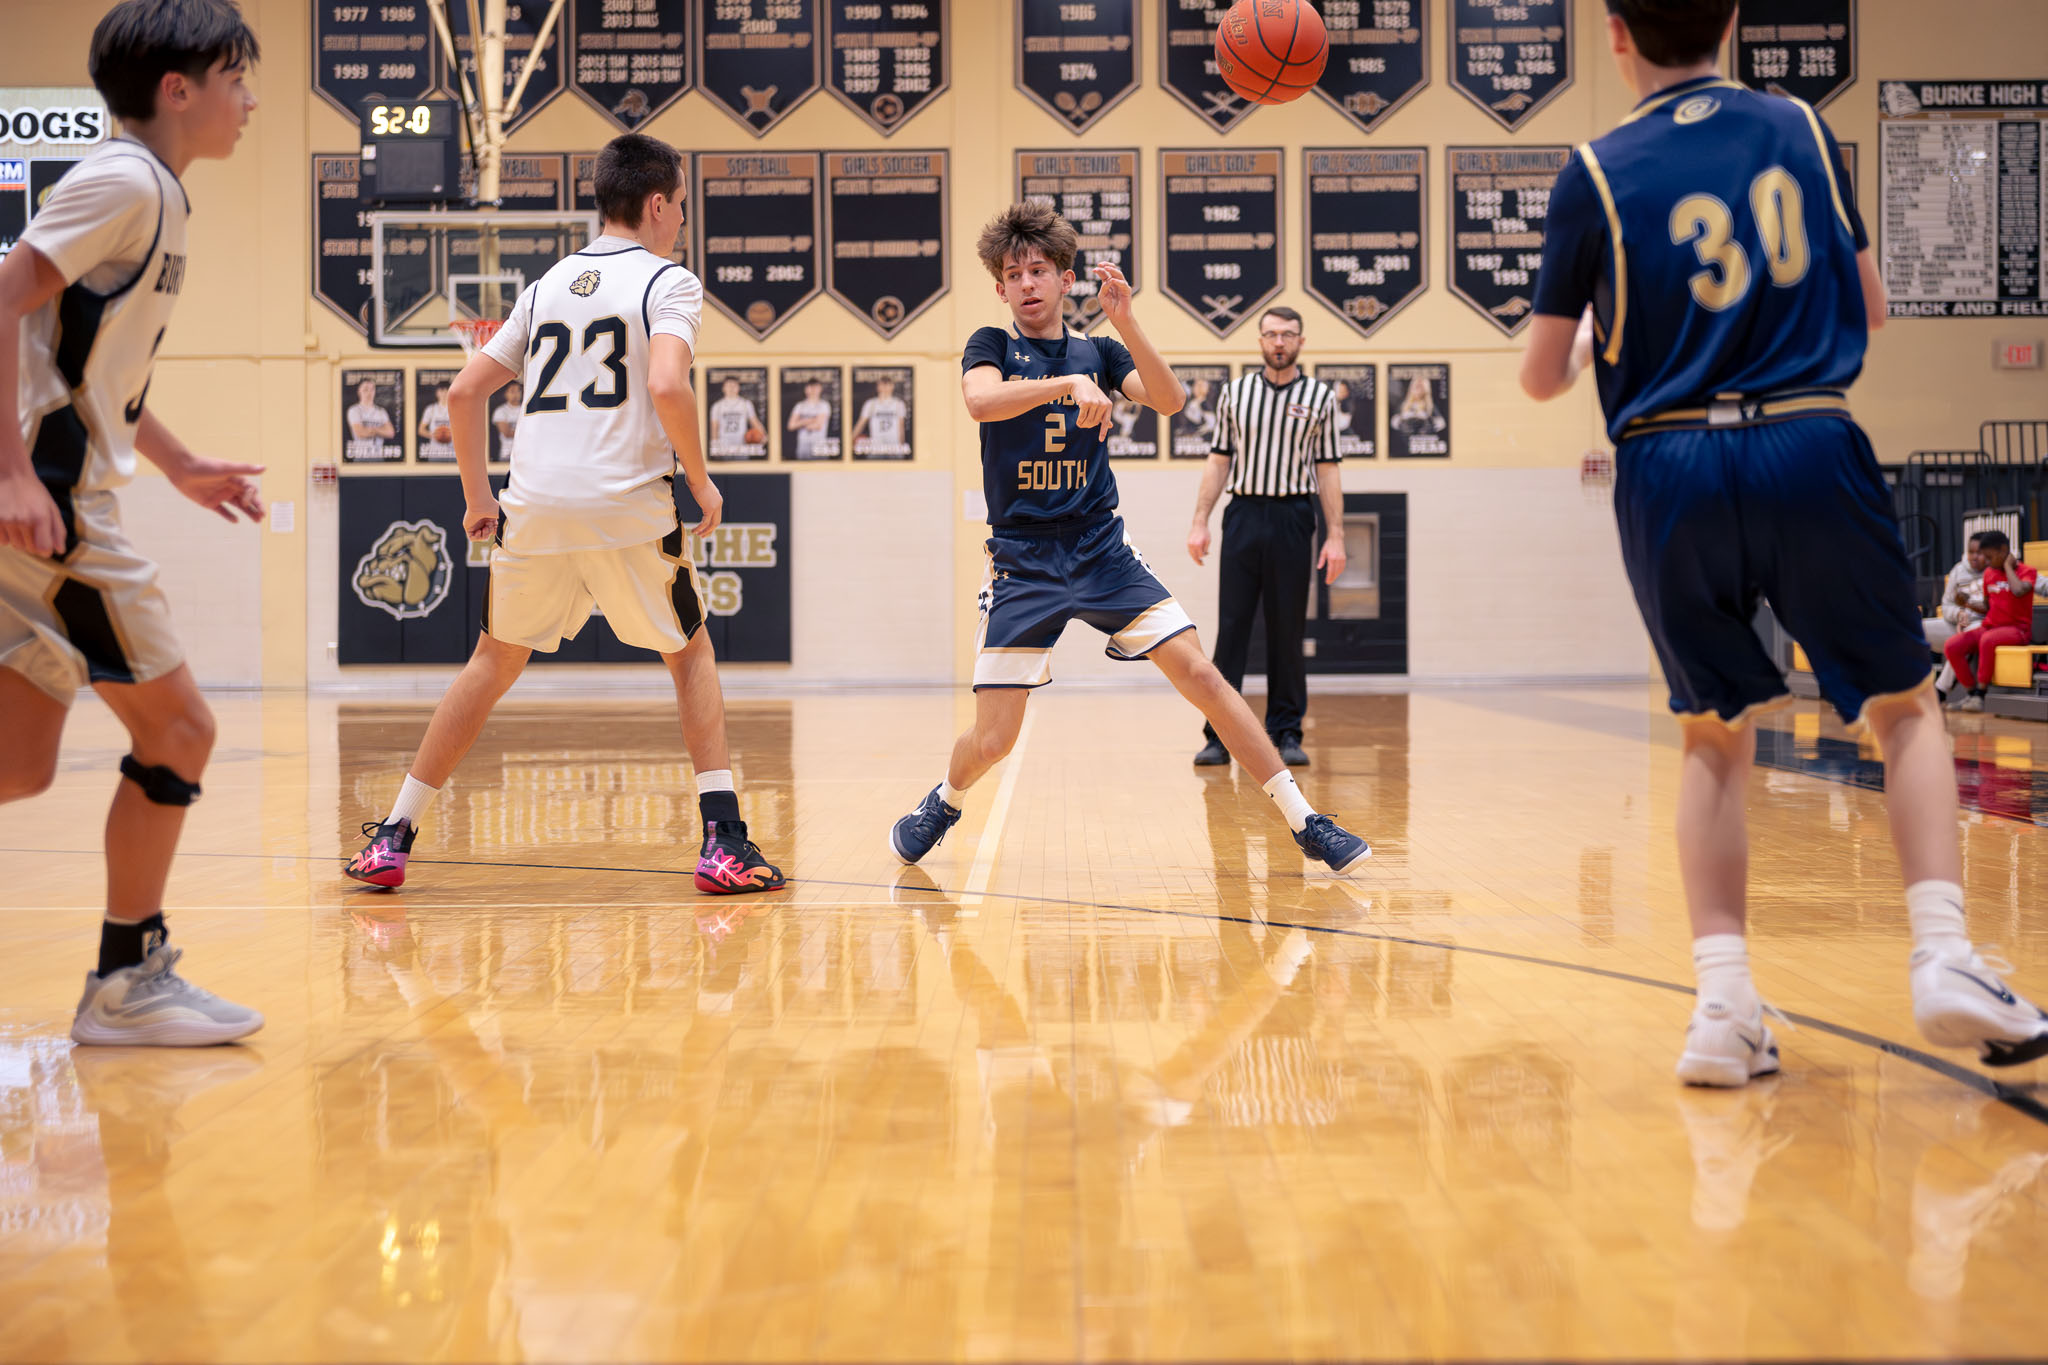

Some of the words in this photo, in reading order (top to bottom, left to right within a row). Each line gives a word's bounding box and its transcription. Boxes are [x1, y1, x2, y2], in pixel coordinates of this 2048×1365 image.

[333, 6, 369, 22] 1977
[1921, 84, 1985, 106] BURKE
[1990, 83, 2037, 105] HIGH
[321, 161, 356, 179] GIRLS
[727, 158, 791, 176] SOFTBALL
[842, 156, 878, 175] GIRLS
[881, 155, 930, 174] SOCCER
[1668, 164, 1811, 313] 30
[1888, 303, 1947, 316] TRACK
[1952, 302, 1997, 315] AND
[524, 313, 630, 417] 23
[1044, 412, 1067, 453] 2
[1017, 459, 1088, 490] SOUTH
